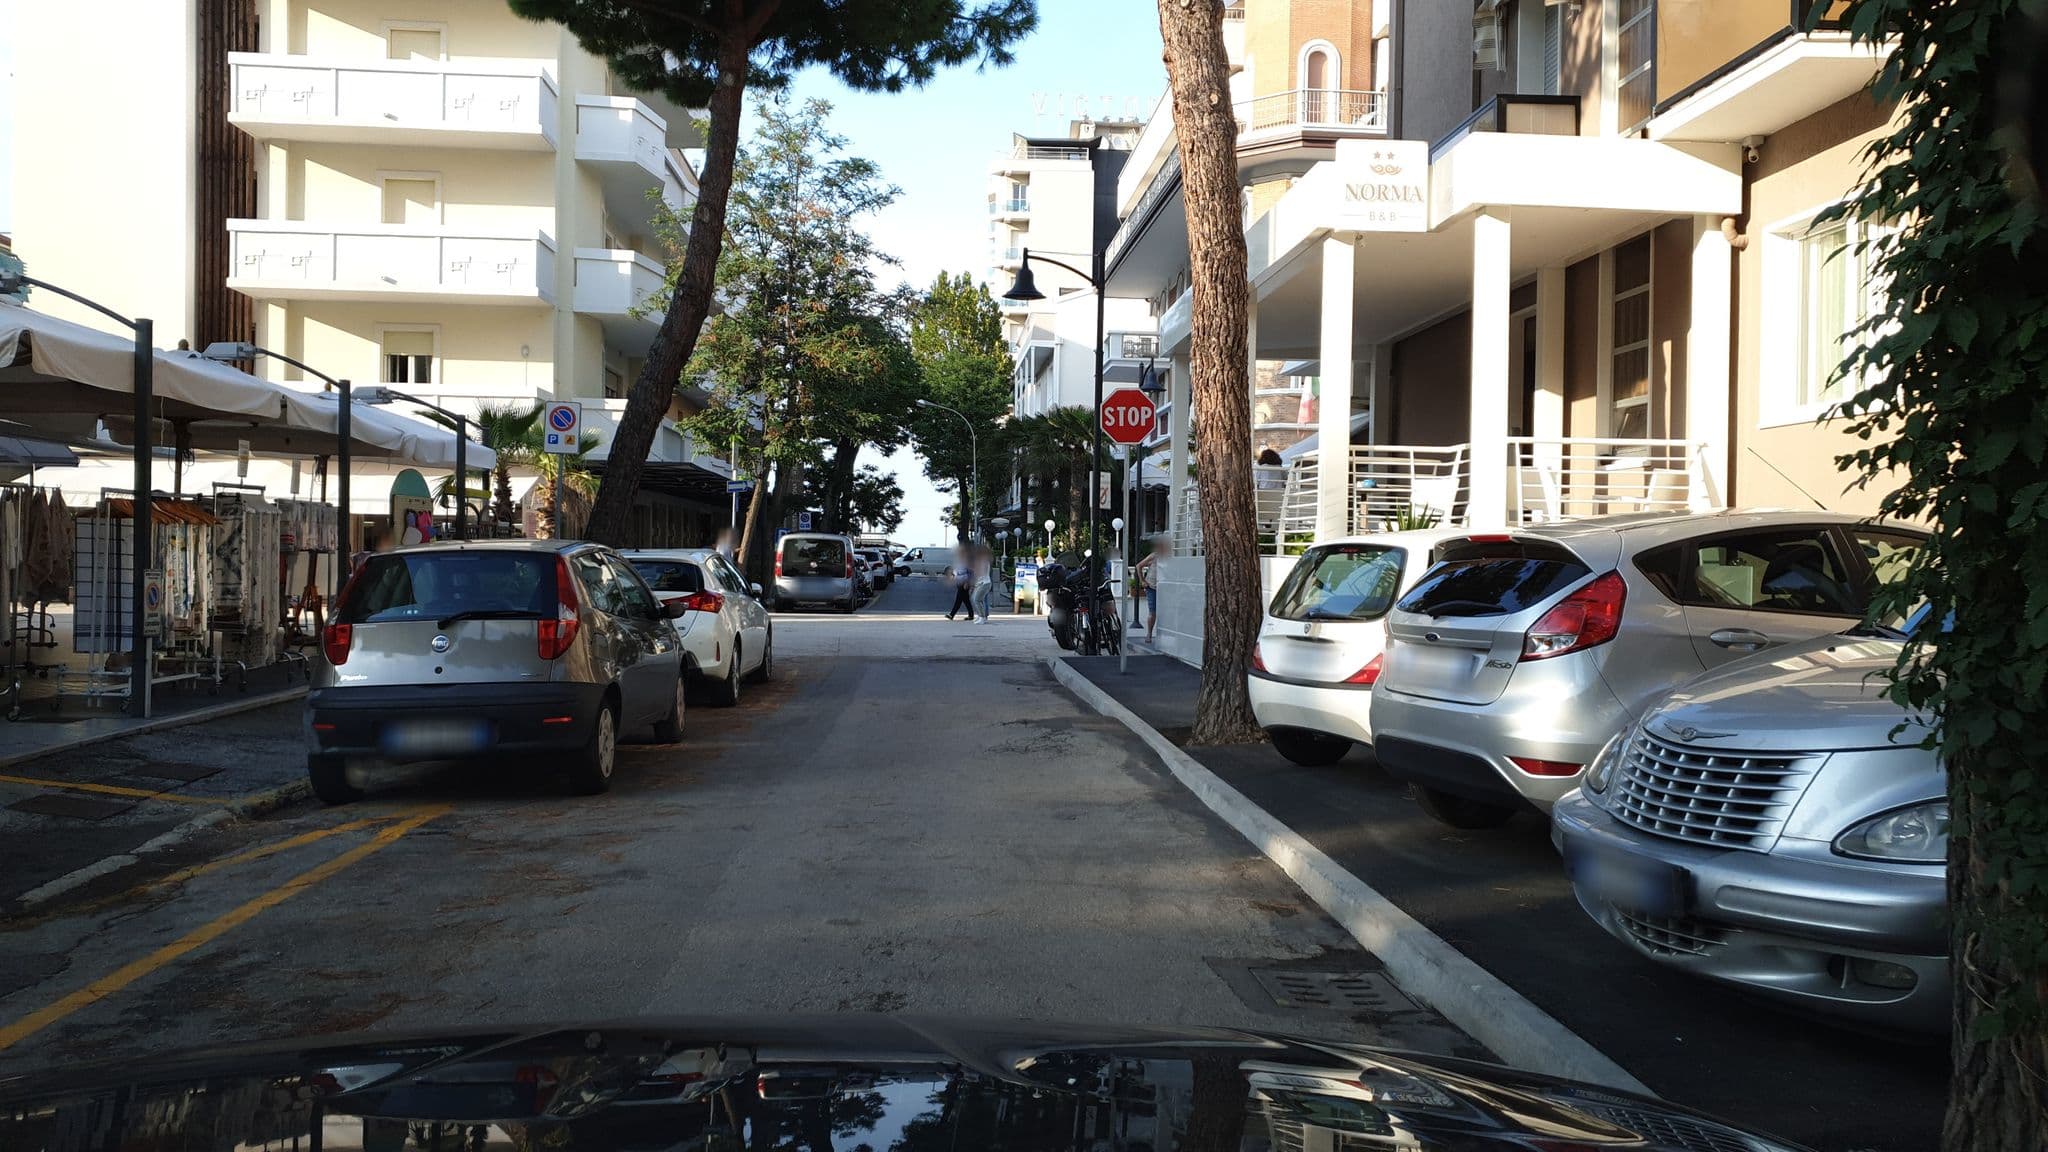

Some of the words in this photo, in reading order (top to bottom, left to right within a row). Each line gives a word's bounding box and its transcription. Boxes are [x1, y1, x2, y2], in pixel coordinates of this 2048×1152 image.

[1345, 183, 1424, 202] NORMA
[1104, 406, 1152, 427] STOP
[550, 435, 557, 443] P
